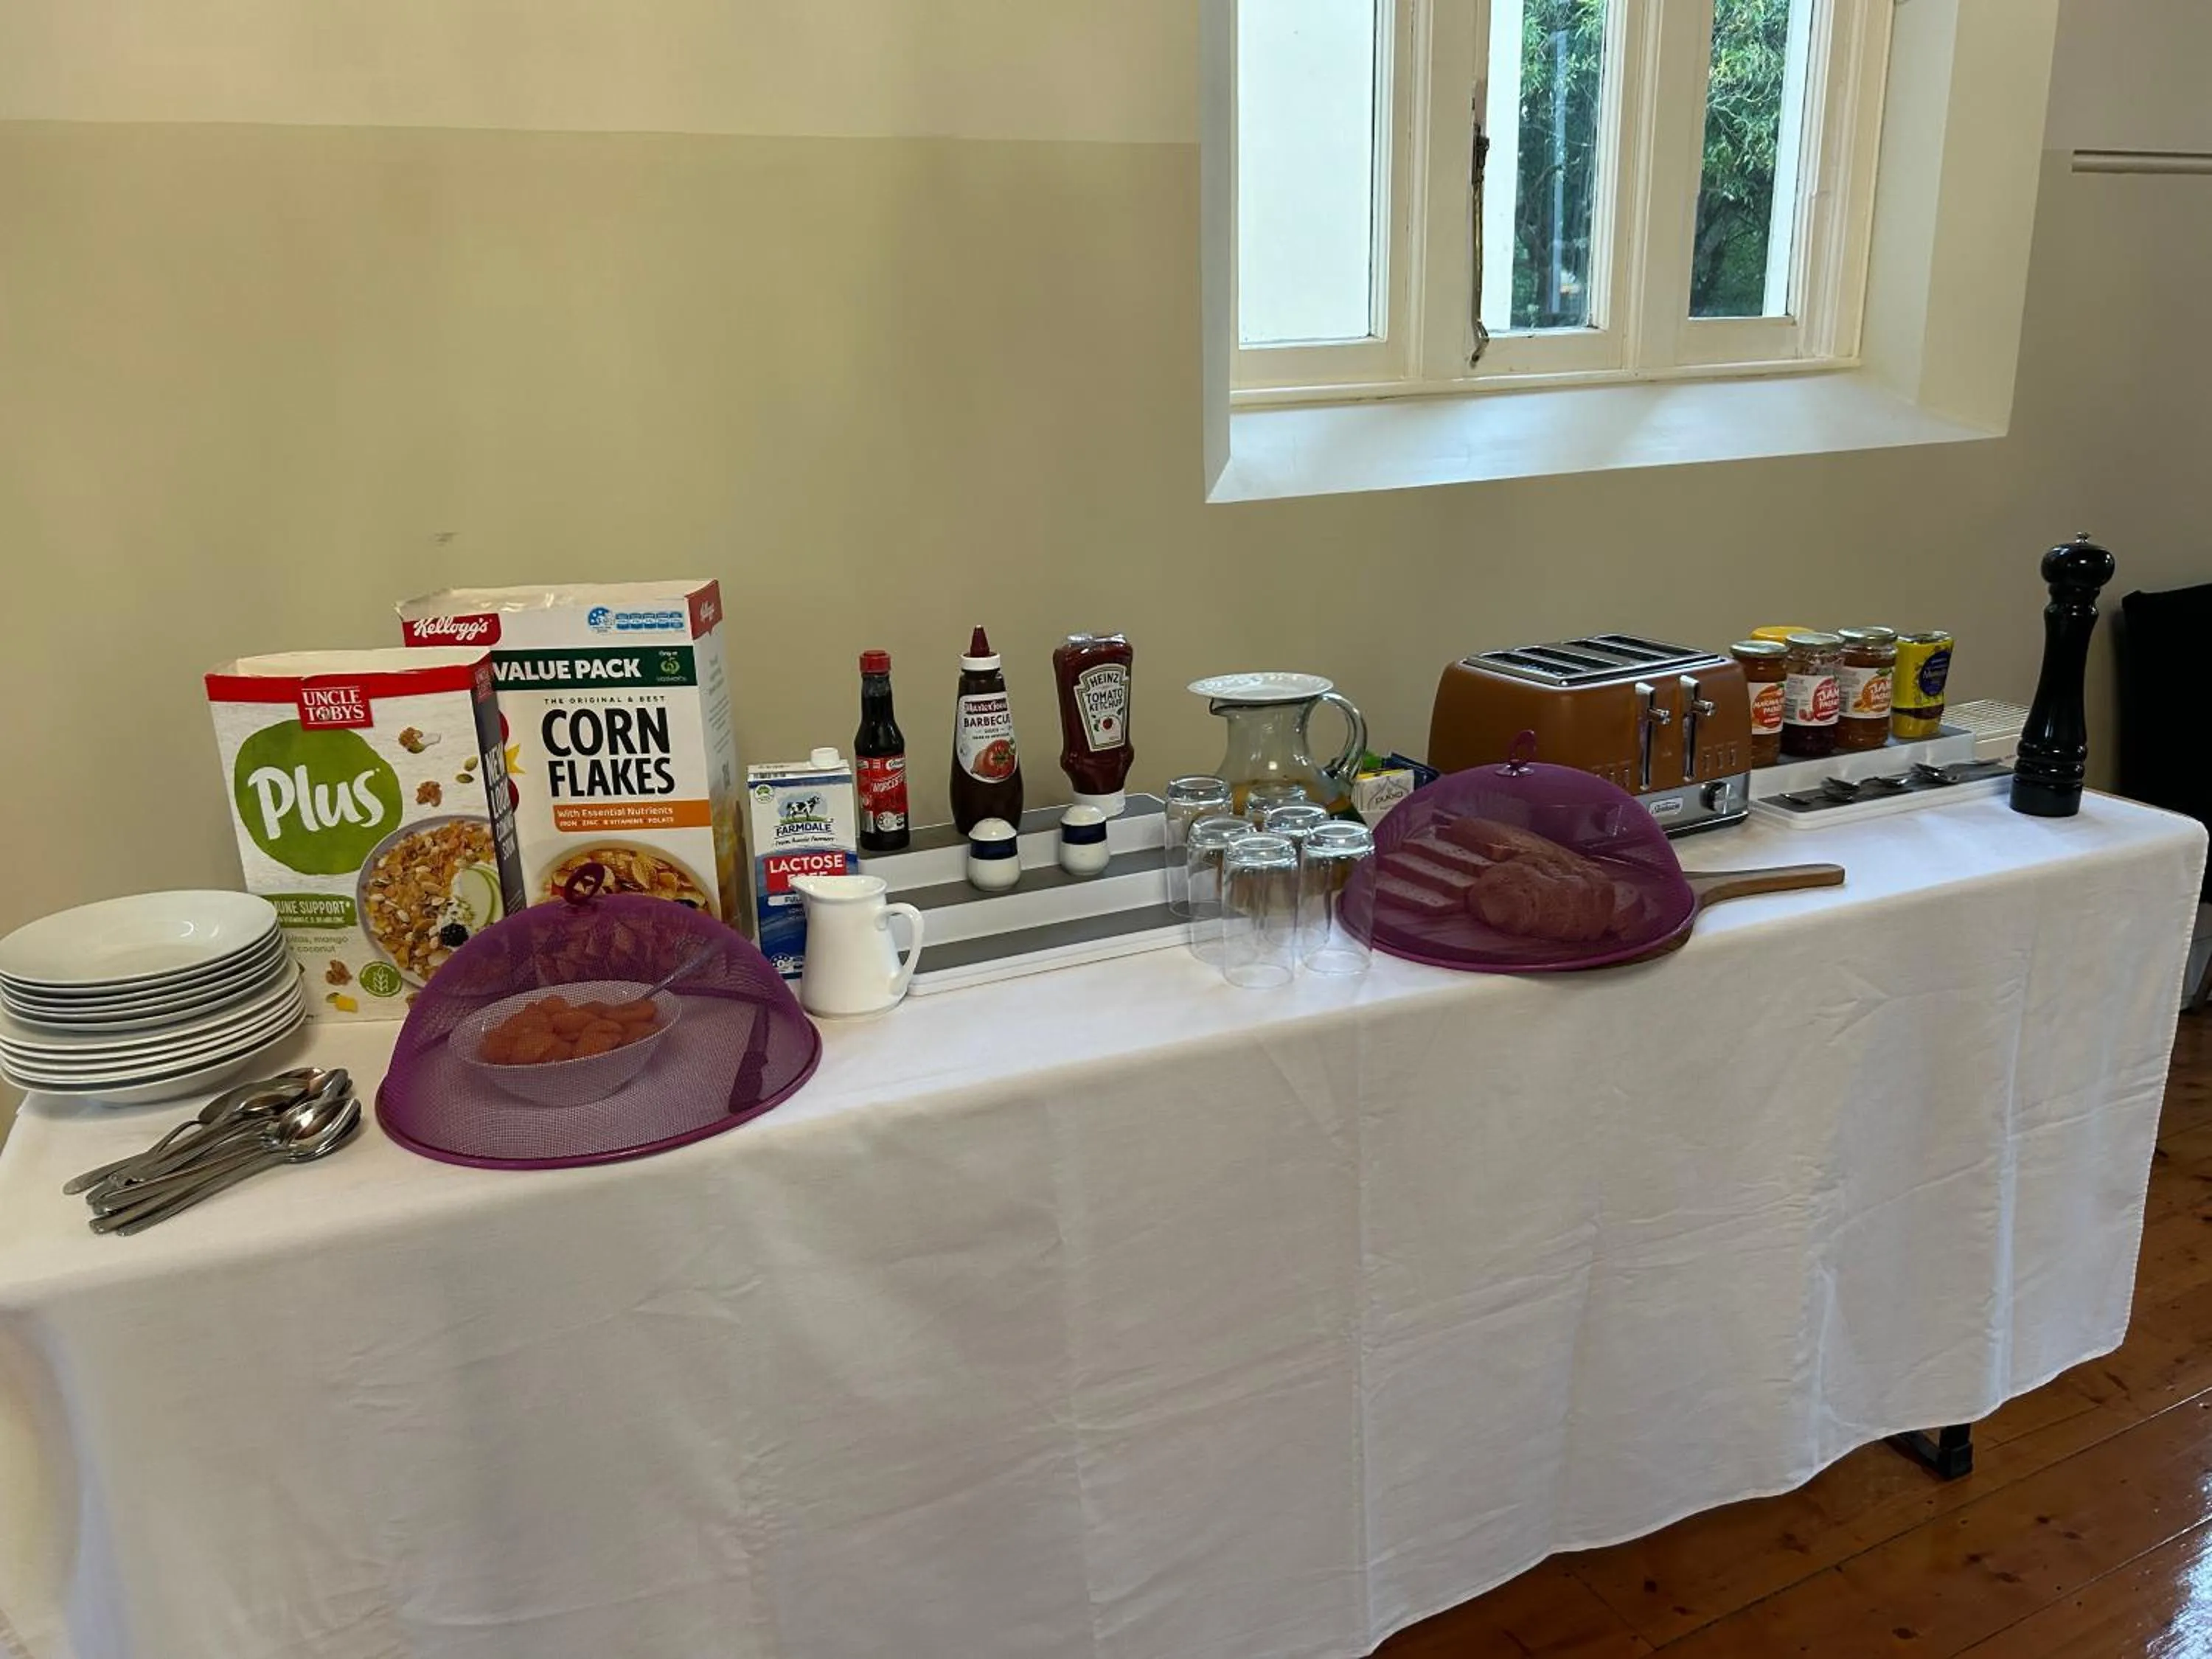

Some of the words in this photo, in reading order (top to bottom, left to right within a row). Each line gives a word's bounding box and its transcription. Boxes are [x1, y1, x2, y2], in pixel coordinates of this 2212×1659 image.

[413, 616, 489, 641] Kellogg's
[493, 660, 571, 681] VALUE
[574, 658, 642, 679] PACK
[1089, 672, 1119, 687] HEINZ
[302, 689, 362, 706] UNCLE
[568, 696, 622, 704] ORIGINAL
[1086, 688, 1123, 703] TOMATO
[305, 704, 365, 721] TOBYS
[1089, 699, 1123, 712] KETCHUP
[541, 707, 670, 757] CORN
[548, 757, 675, 797] FLAKES
[248, 765, 384, 840] Plus
[582, 807, 626, 818] Essential
[627, 807, 673, 815] Nutrients
[776, 822, 832, 837] FARMDALE
[769, 853, 844, 874] LACTOSE
